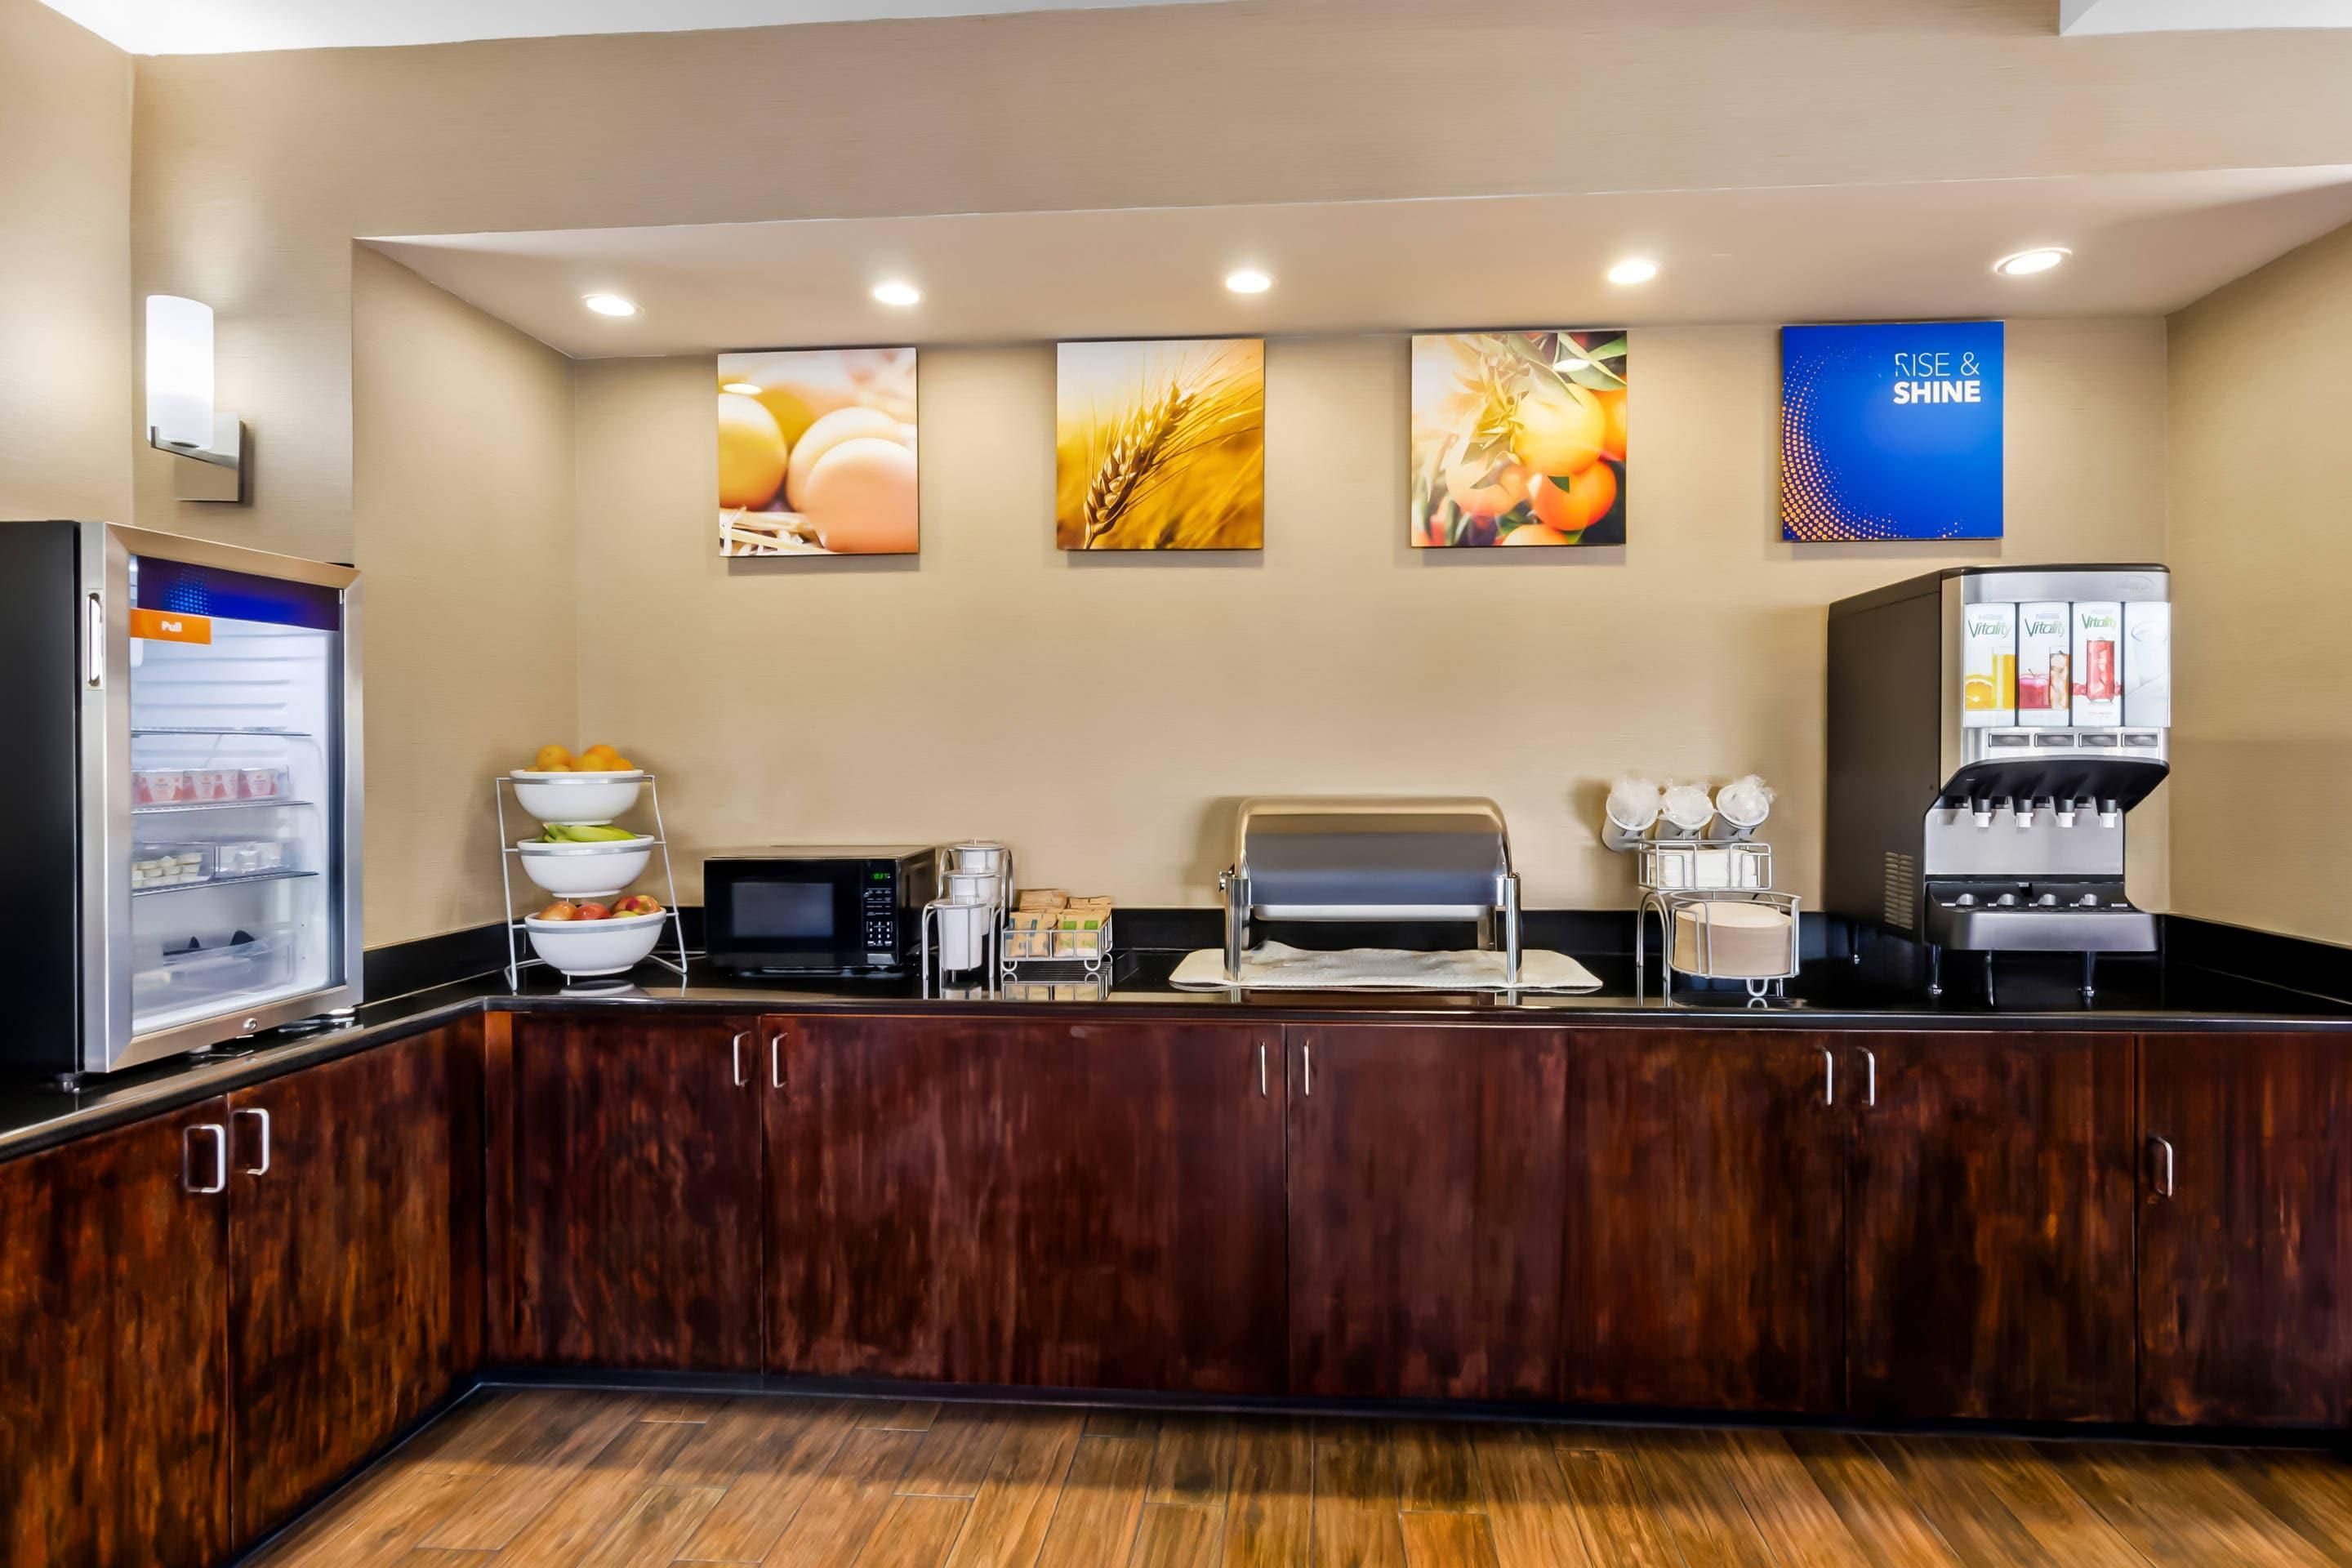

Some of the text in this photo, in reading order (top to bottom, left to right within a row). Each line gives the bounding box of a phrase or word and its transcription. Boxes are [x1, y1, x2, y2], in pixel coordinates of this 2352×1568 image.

[1895, 351, 1980, 377] RISE &
[1893, 380, 1981, 404] SHINE
[161, 621, 183, 633] Pull
[1967, 618, 2011, 639] Vitality
[2025, 617, 2065, 638] Vitality
